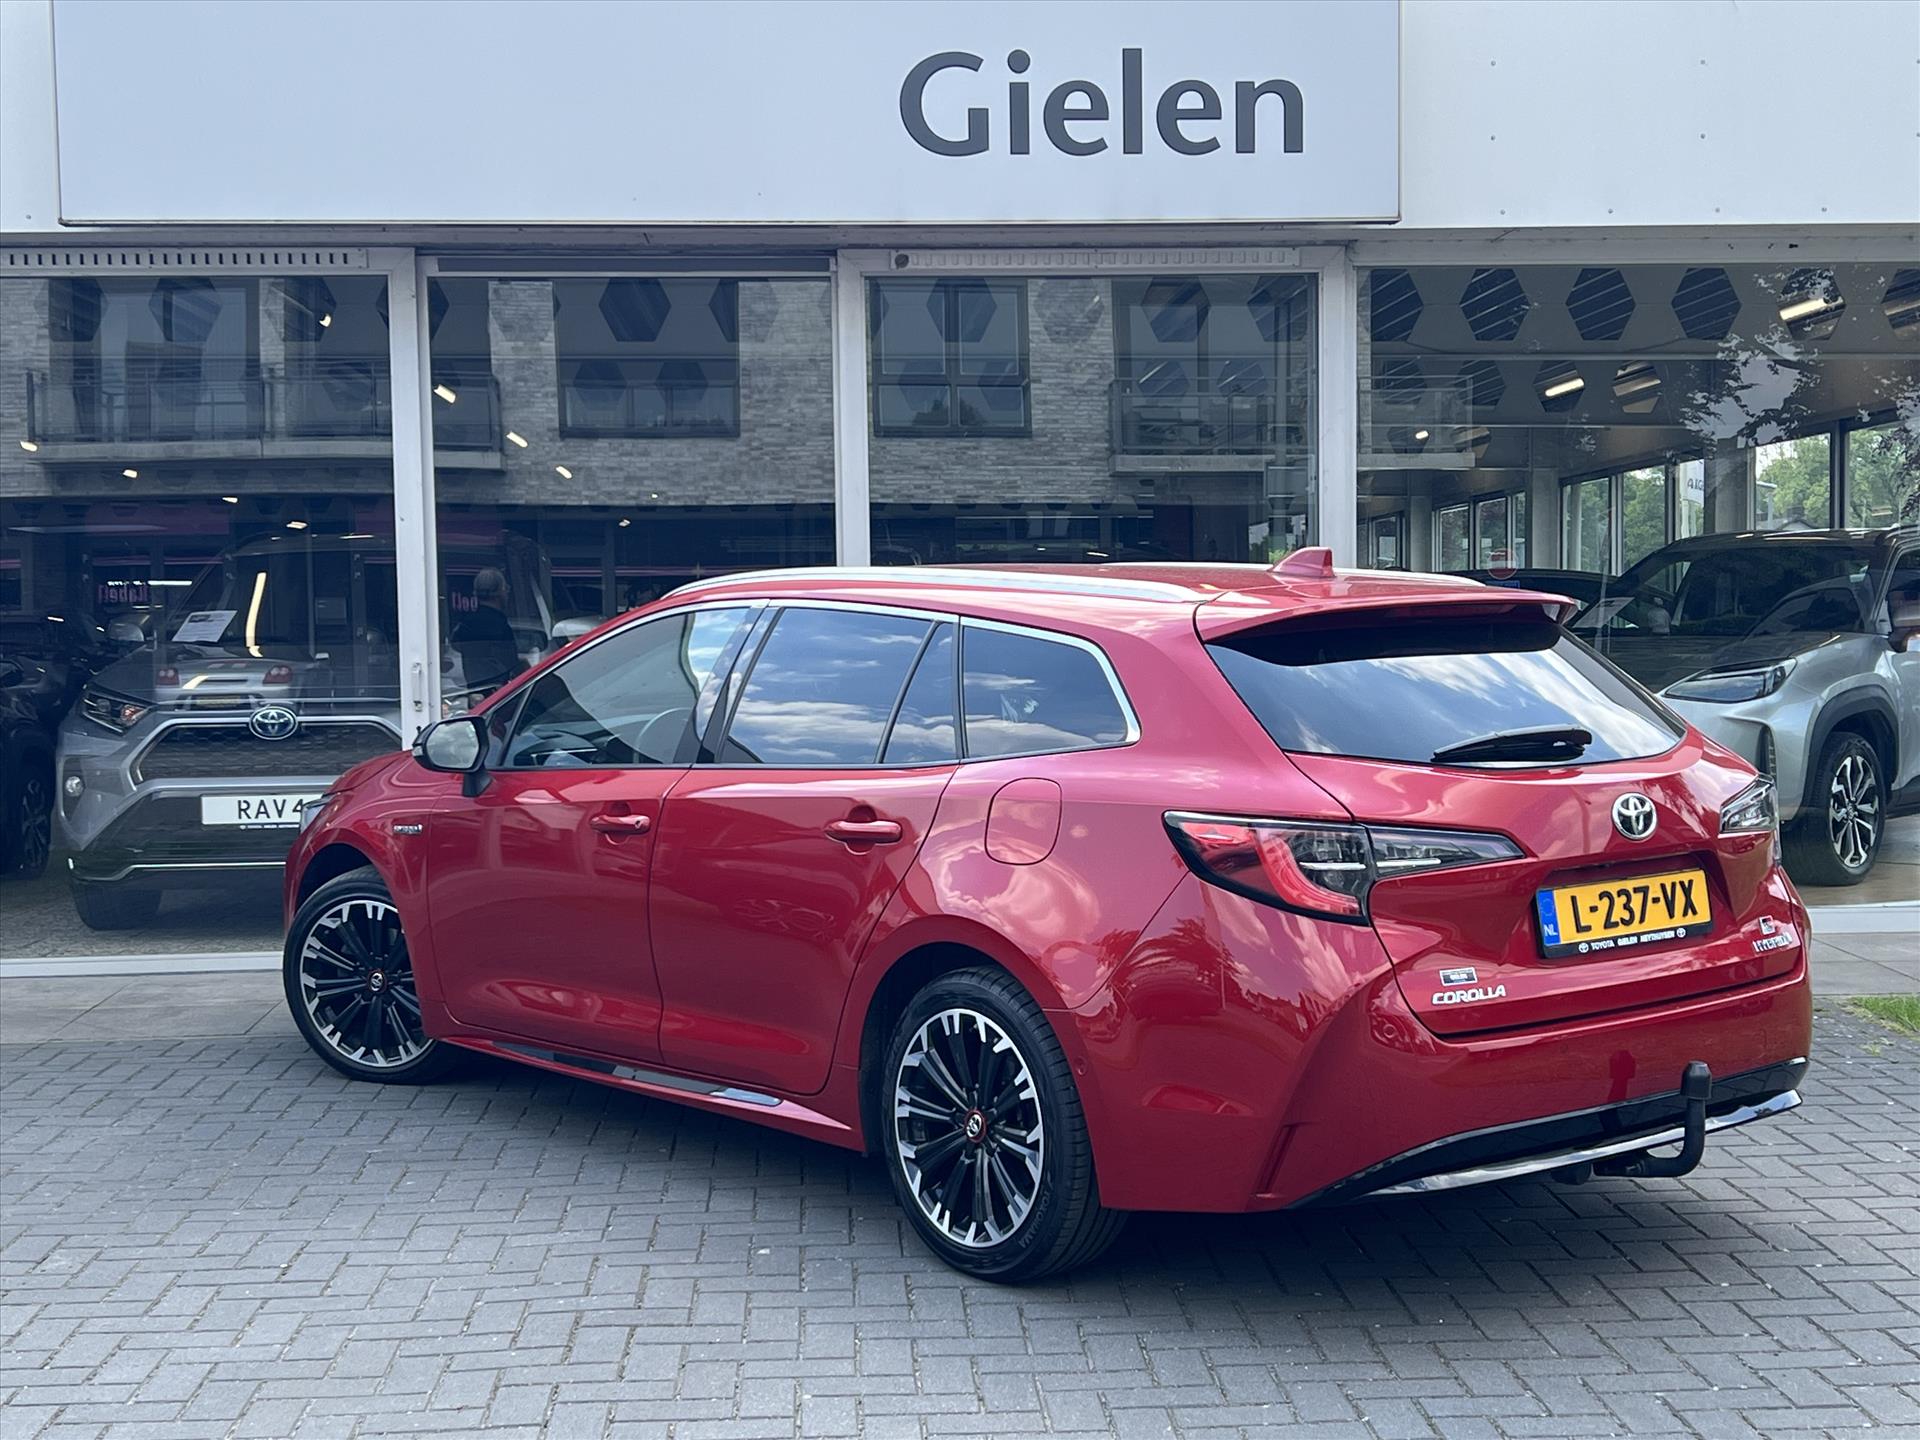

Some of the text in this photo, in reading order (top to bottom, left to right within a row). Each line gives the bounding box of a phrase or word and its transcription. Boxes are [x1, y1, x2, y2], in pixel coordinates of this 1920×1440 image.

[899, 47, 1304, 157] Gielen
[1570, 879, 1698, 934] L-237-VX
[1543, 923, 1558, 937] NL
[1432, 984, 1506, 1005] COROLLA
